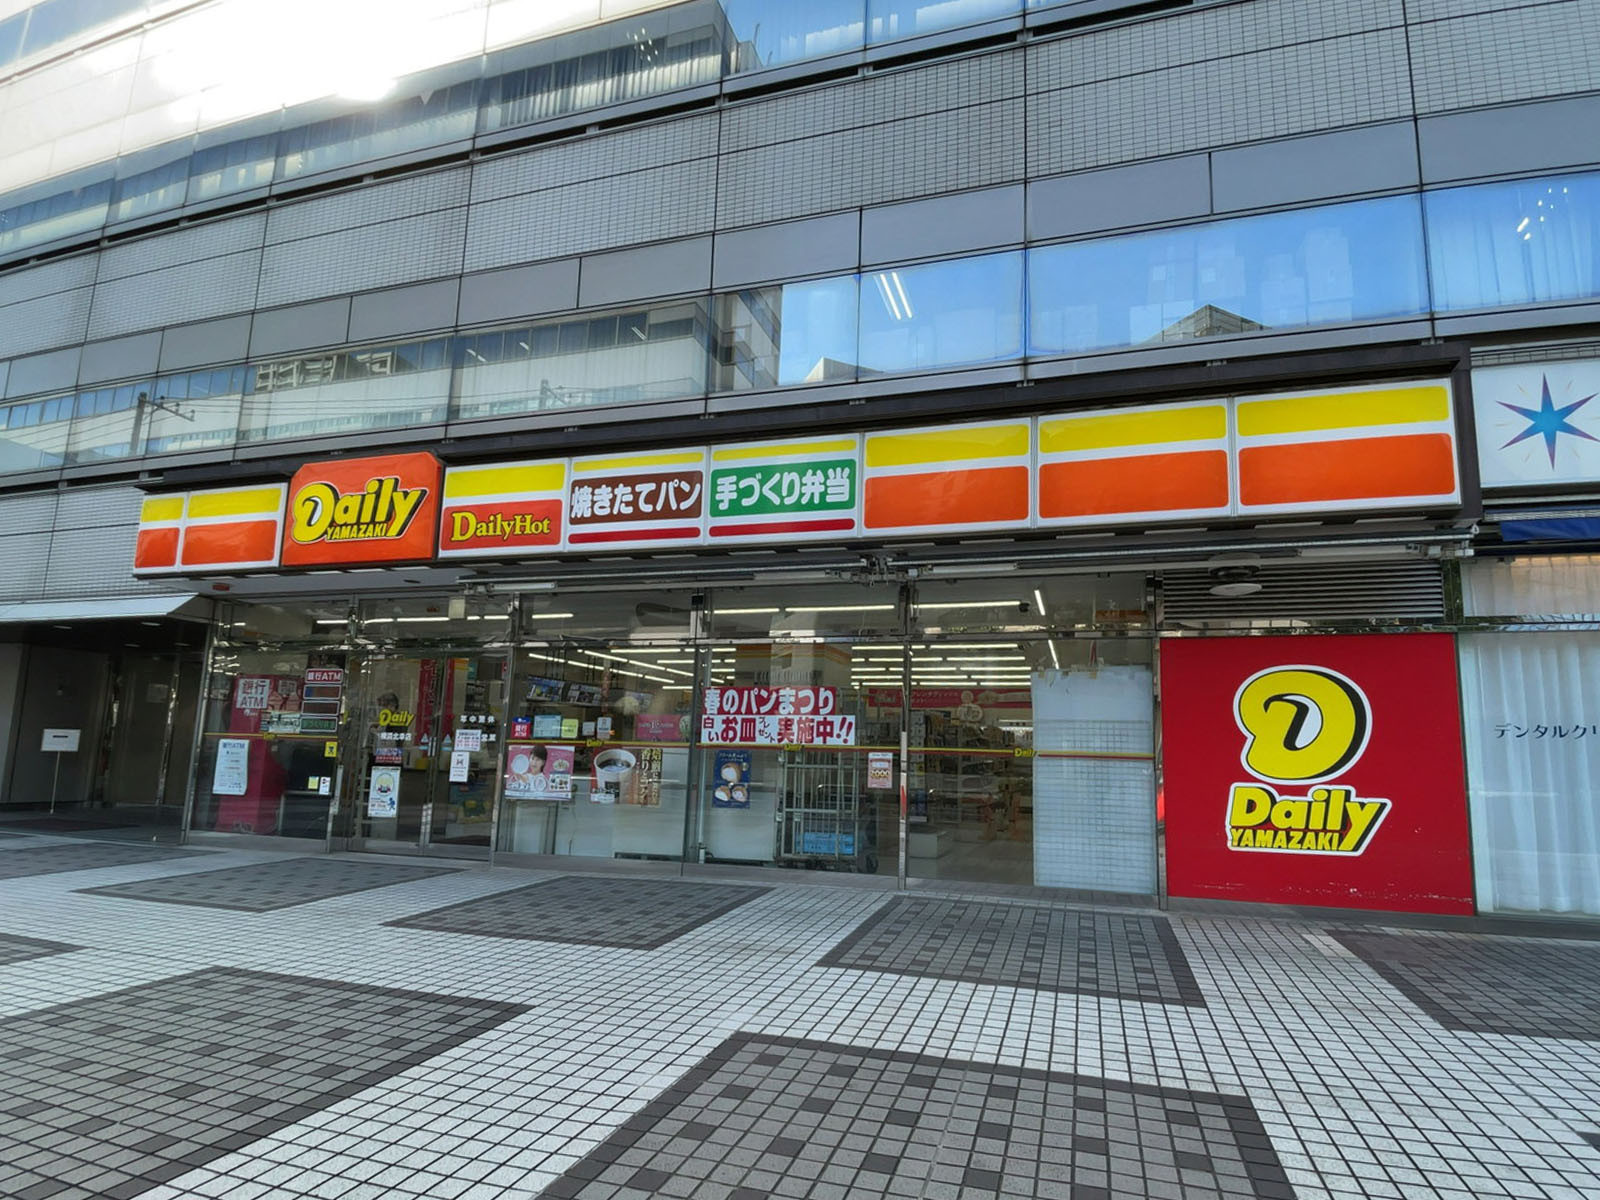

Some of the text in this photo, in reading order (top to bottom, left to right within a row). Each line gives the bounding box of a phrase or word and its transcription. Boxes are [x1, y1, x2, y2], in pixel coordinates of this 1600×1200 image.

[571, 479, 701, 518] 焼きたてパン
[715, 466, 850, 510] 手づくり弁当
[293, 477, 426, 542] Daily
[326, 523, 386, 540] YAMAZAKI
[451, 512, 551, 541] DailyHot
[240, 696, 265, 707] ATM
[704, 687, 834, 715] 春のパンまつり
[379, 708, 415, 726] Daily
[1231, 786, 1388, 851] Daily
[1231, 828, 1339, 850] YAMAZAKI
